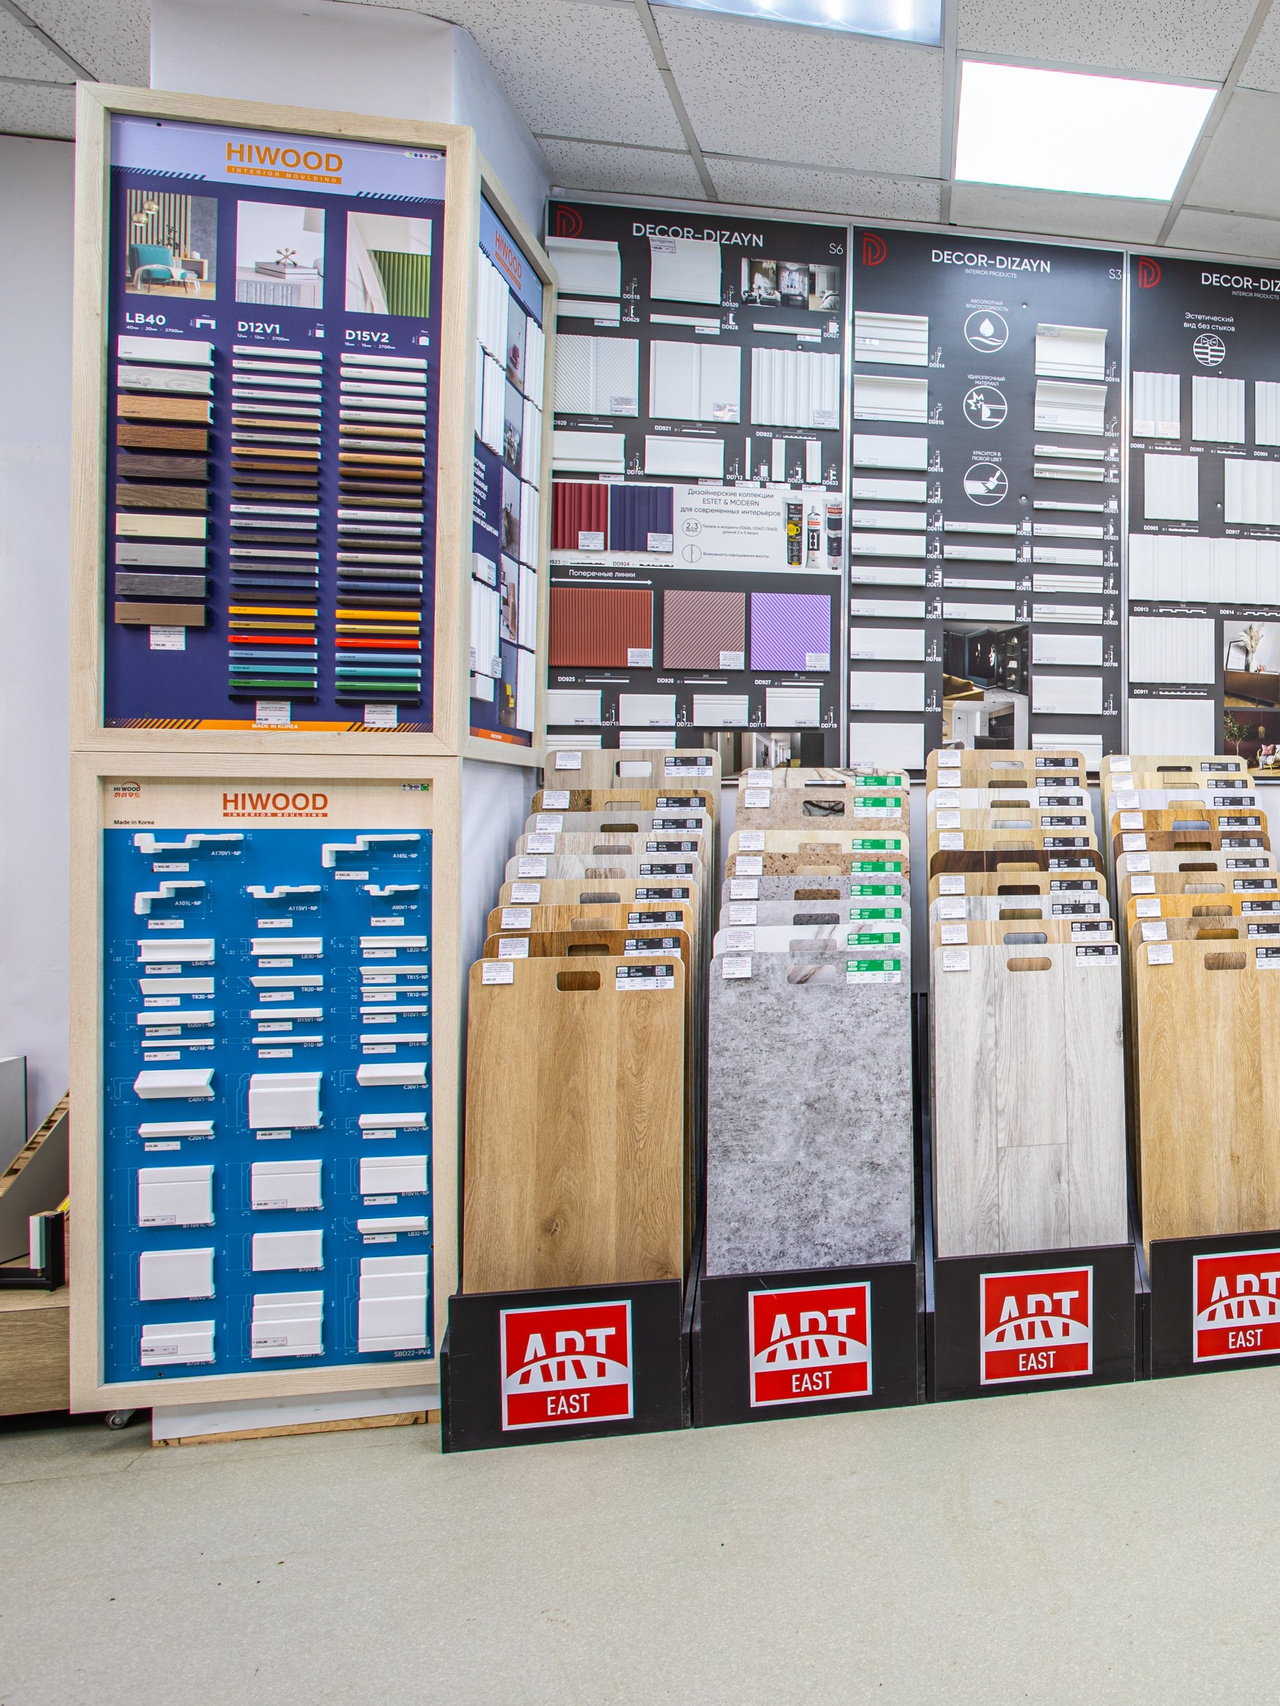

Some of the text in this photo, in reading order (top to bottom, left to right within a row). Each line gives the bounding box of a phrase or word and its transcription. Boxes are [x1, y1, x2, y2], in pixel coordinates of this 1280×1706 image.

[226, 142, 343, 173] HIWOOD
[230, 166, 337, 184] INTERIOR MOULDING
[632, 222, 764, 248] DECOR-DIZAYN
[494, 230, 523, 280] HIWOOD
[828, 243, 844, 255] S6
[932, 250, 1051, 273] DECOR-DIZAYN
[1108, 268, 1122, 280] S3
[125, 312, 166, 326] LB40
[1183, 322, 1196, 330] вид
[1198, 322, 1210, 330] без
[1185, 312, 1234, 323] Эстетический
[237, 321, 281, 334] D12V1
[345, 330, 390, 342] D15V2
[688, 489, 737, 498] Дизайнерские
[694, 508, 740, 516] современных
[742, 509, 781, 517] интерьеров
[569, 570, 636, 579] Поперечные линии
[223, 793, 328, 810] HIWOOD
[996, 1290, 1079, 1342] ART
[766, 1308, 856, 1363] ART
[1228, 1330, 1264, 1349] EAST
[394, 1349, 431, 1358] SBD22-PV4
[519, 1326, 616, 1385] ART
[1018, 1351, 1056, 1371] EAST
[792, 1371, 832, 1393] EAST
[546, 1393, 590, 1416] EAST
